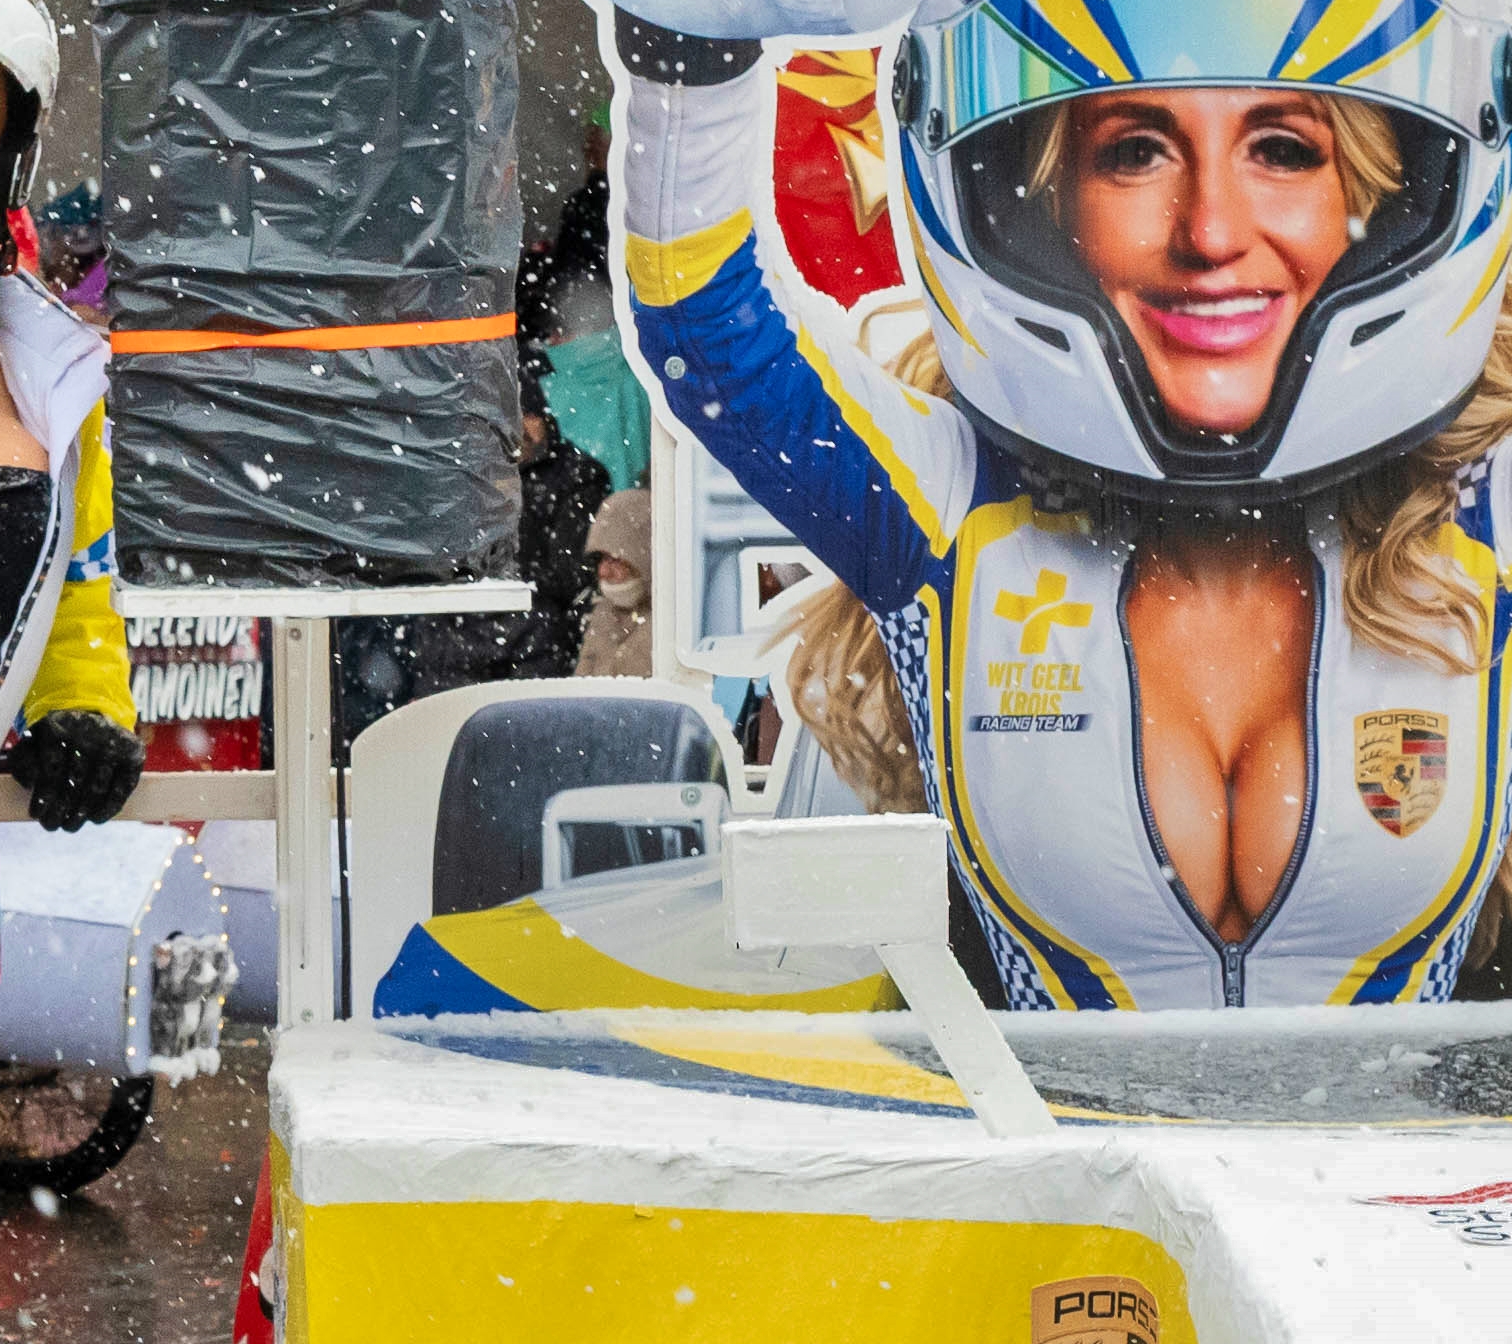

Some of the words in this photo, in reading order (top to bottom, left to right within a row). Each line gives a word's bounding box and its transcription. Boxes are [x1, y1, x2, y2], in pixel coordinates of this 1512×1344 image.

[988, 663, 1027, 687] WIT
[1032, 663, 1084, 692] GEEL
[1000, 690, 1062, 716] KROIS
[980, 716, 1031, 730] RACING
[1036, 715, 1080, 729] TEAM
